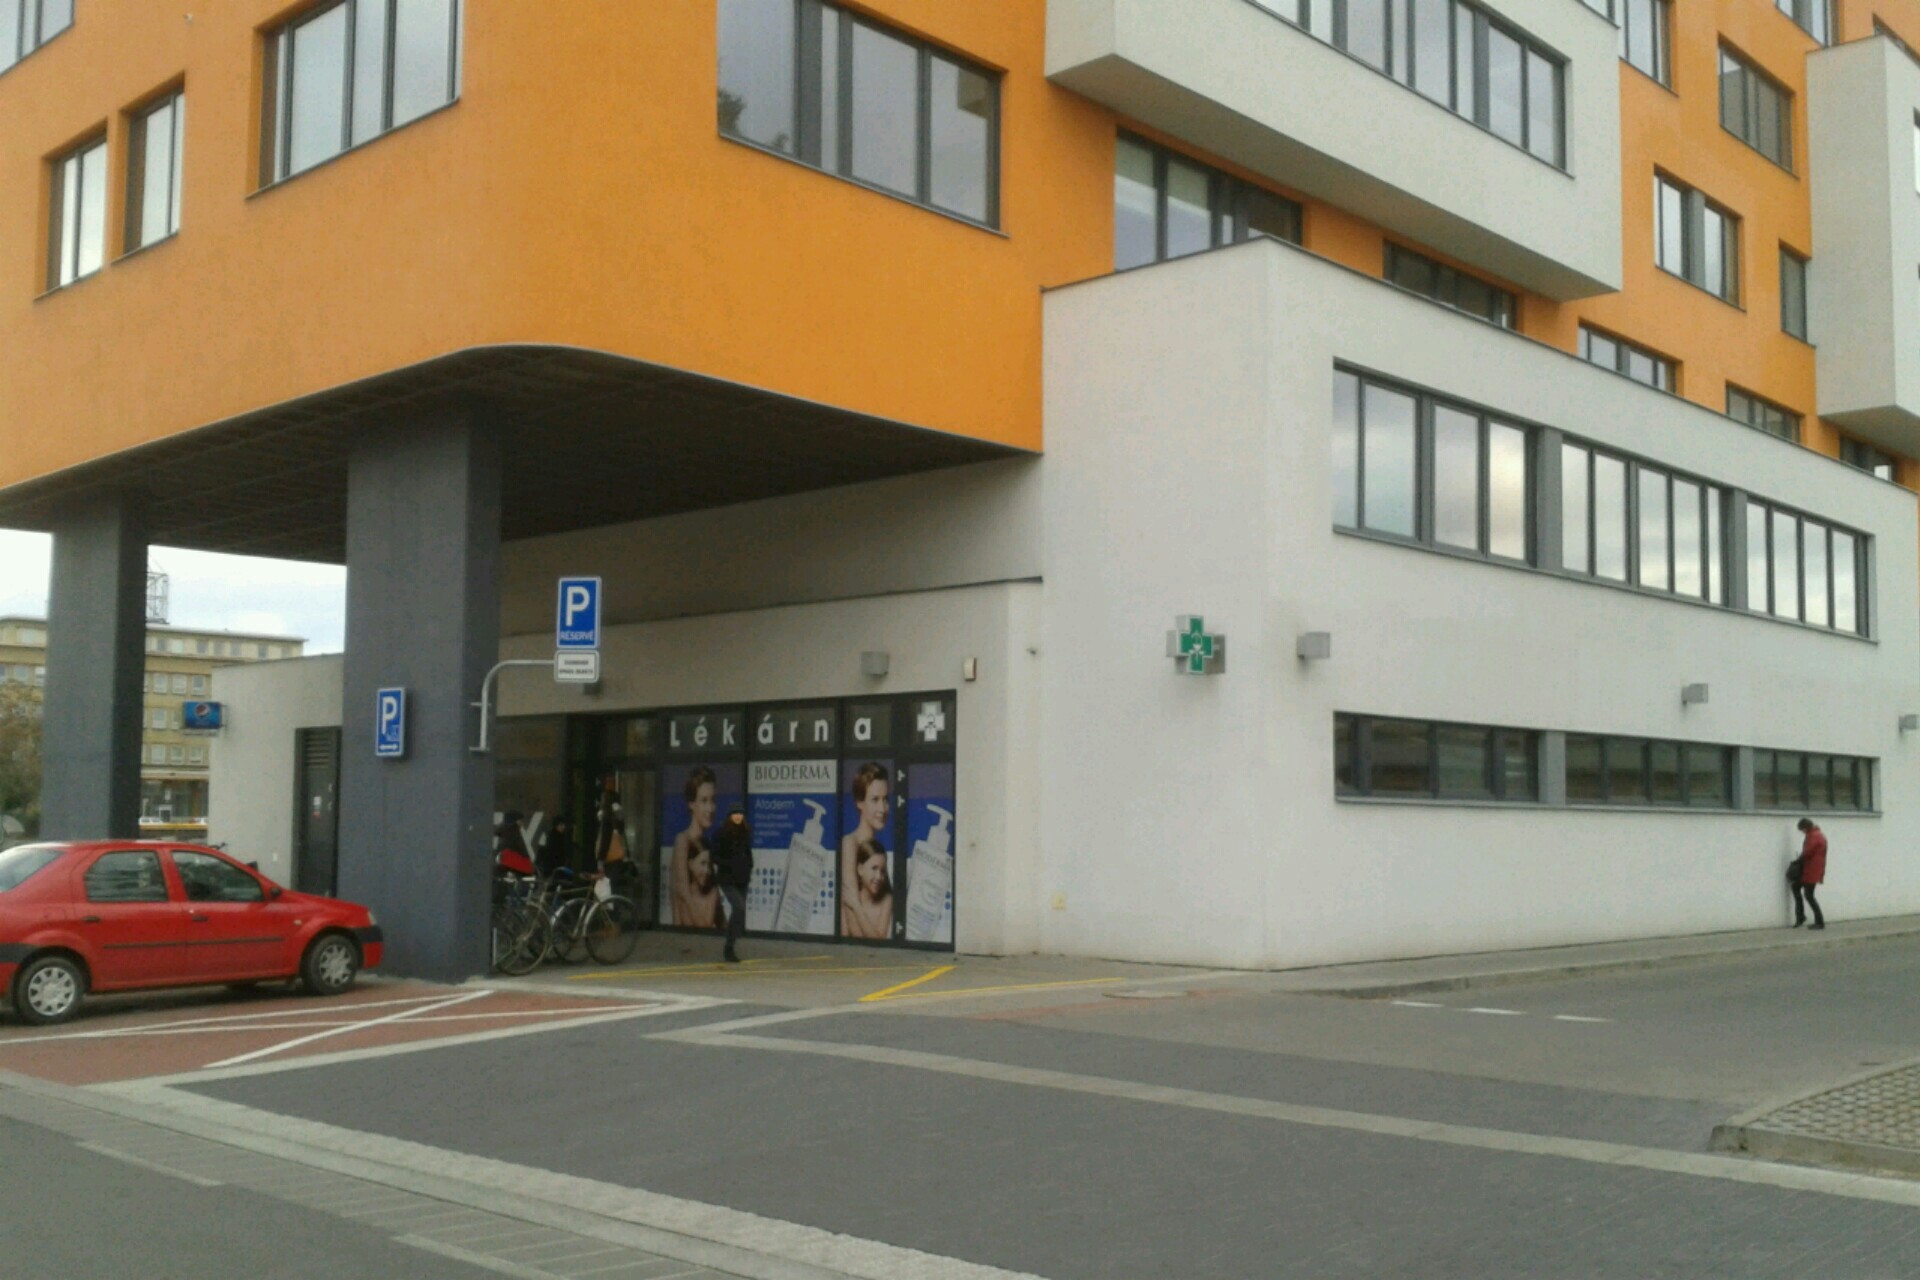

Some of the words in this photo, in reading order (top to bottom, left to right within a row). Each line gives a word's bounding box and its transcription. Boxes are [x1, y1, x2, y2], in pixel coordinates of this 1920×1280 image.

[566, 586, 590, 627] P
[381, 696, 397, 735] P
[670, 714, 871, 747] Lékárna
[754, 765, 831, 780] BIODERMA
[754, 798, 795, 810] Atoderm
